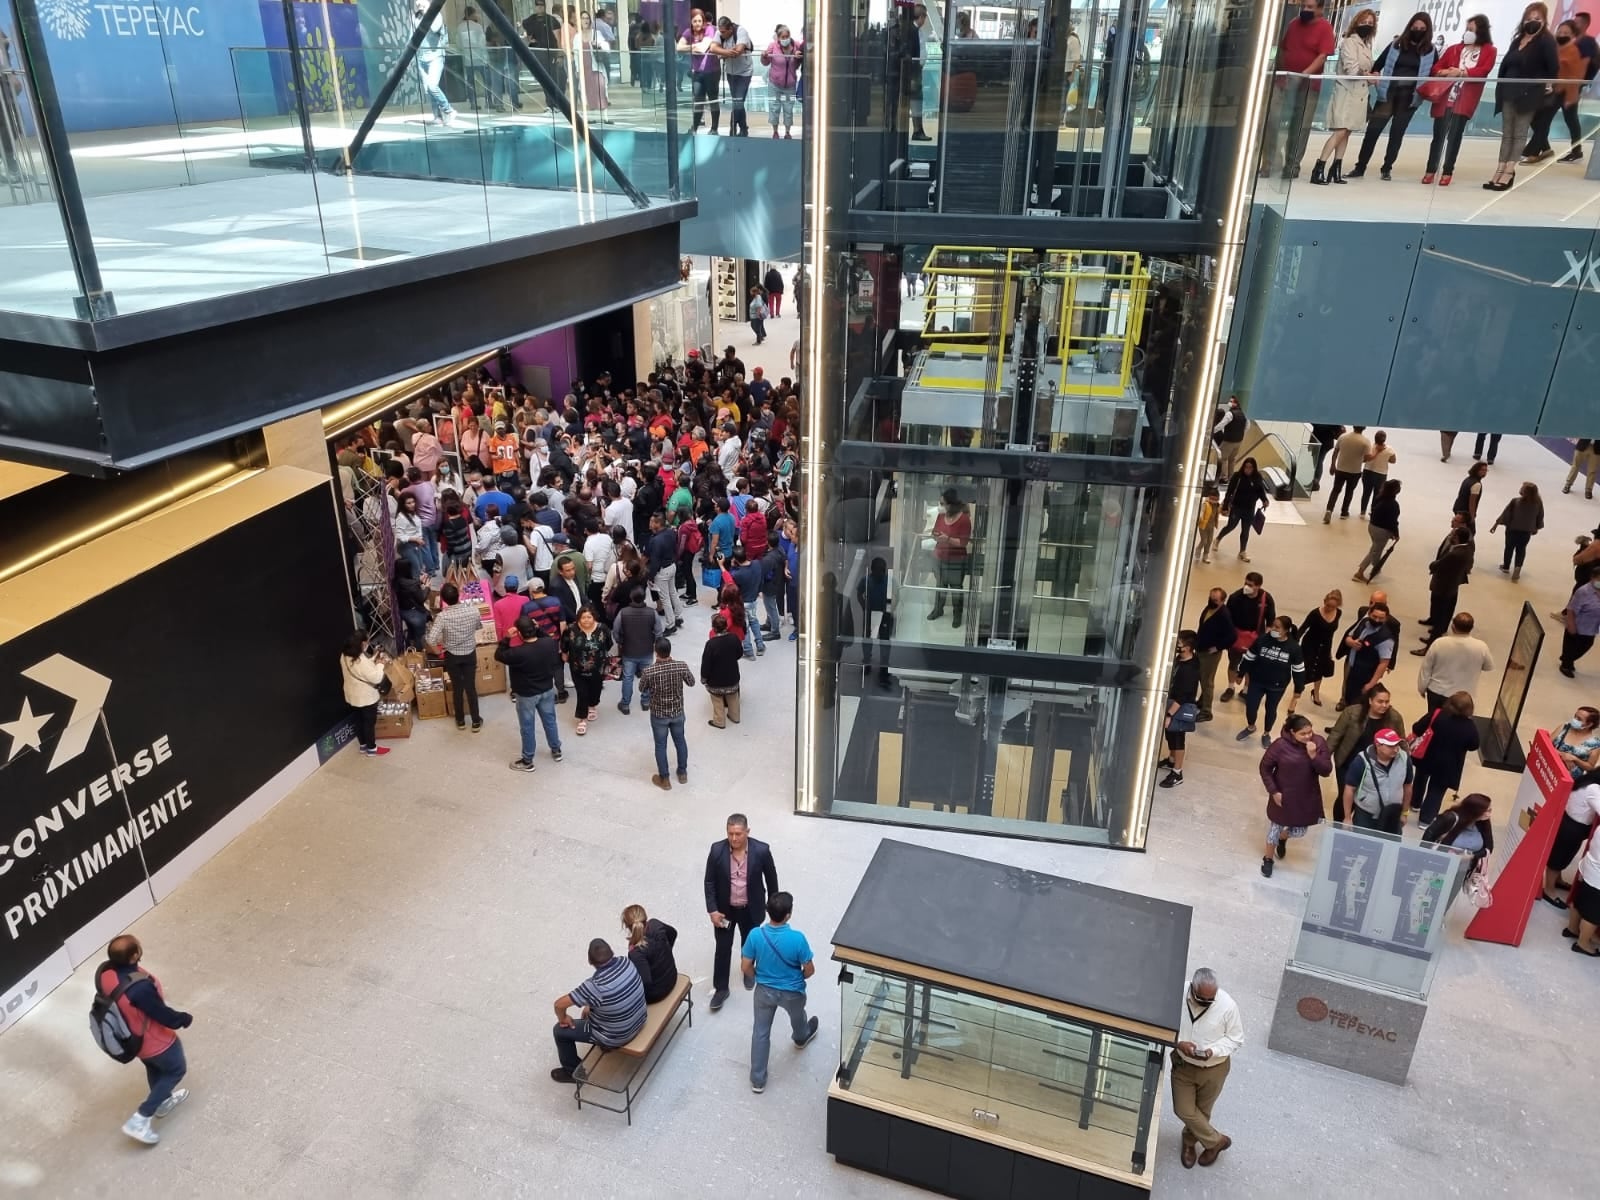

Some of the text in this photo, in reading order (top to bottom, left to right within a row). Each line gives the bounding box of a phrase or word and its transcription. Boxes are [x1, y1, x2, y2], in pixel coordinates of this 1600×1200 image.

[94, 4, 205, 37] TEPEYAC
[1416, 0, 1465, 32] ties
[0, 734, 174, 876] CONVERSE
[1328, 1013, 1398, 1042] TEPEYAC
